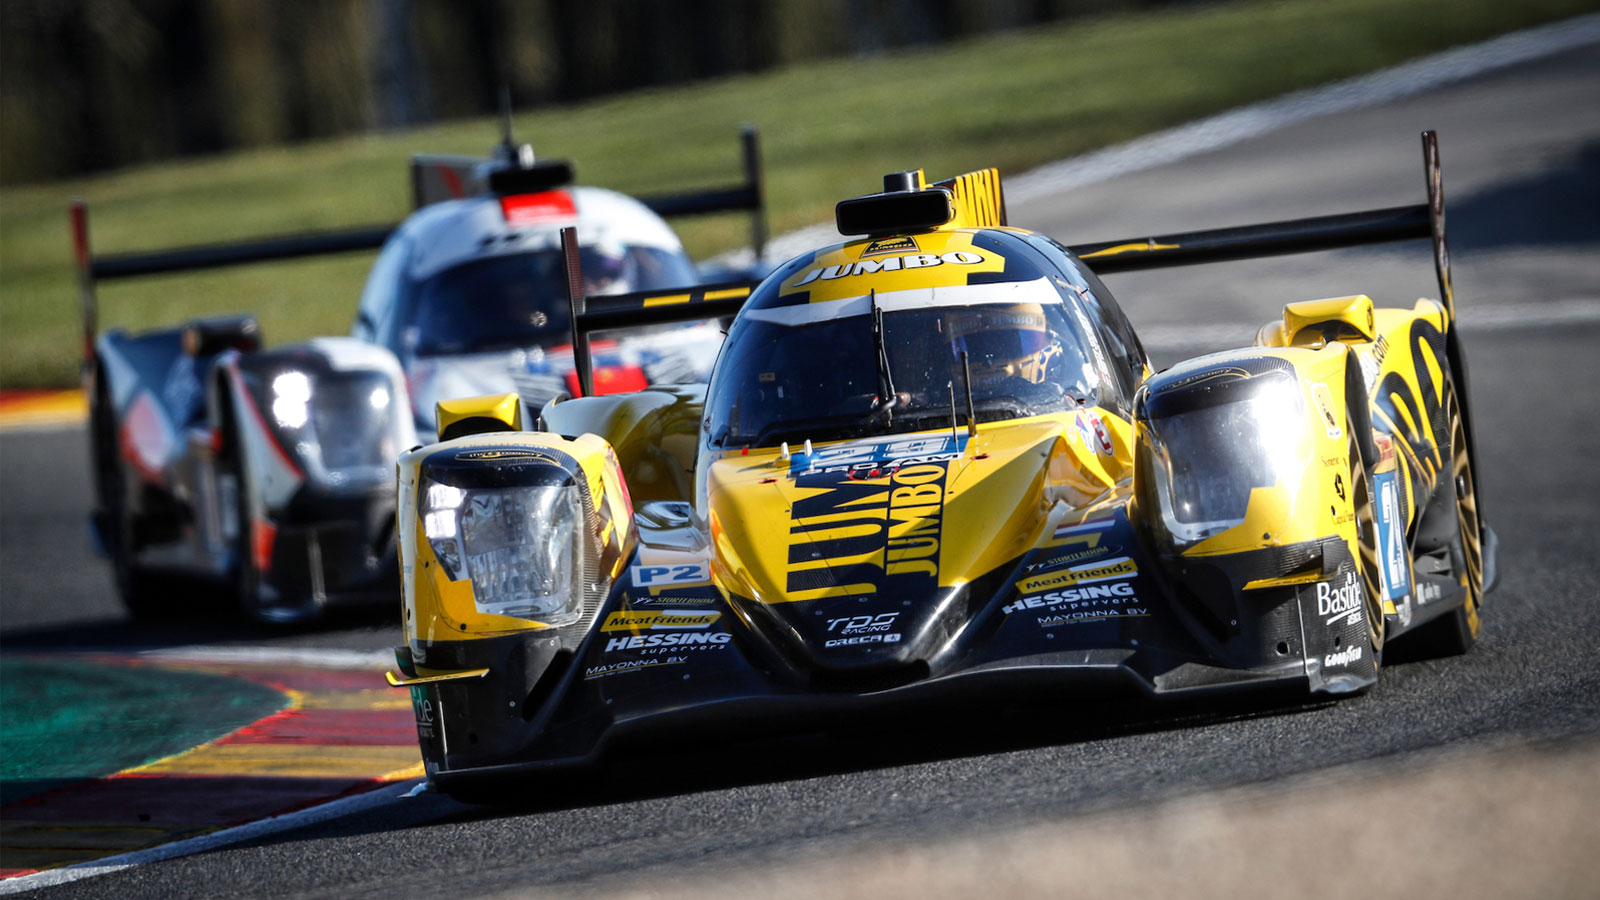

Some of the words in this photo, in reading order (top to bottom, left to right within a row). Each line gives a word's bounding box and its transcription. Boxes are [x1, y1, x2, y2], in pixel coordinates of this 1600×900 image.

[793, 251, 985, 287] JUMBO
[886, 464, 946, 578] JUMBO
[639, 565, 703, 583] P2
[1002, 582, 1135, 615] HESSING
[1317, 572, 1362, 615] Bastide
[1050, 597, 1139, 612] supervers
[826, 611, 900, 631] TDS
[1037, 608, 1120, 624] MAYONNA
[1127, 607, 1148, 615] BV
[841, 624, 892, 635] RACING
[604, 632, 733, 652] HESSING
[640, 643, 726, 655] supervers
[825, 634, 883, 648] ORECA
[585, 659, 659, 675] MAYONNA
[666, 655, 689, 663] BV
